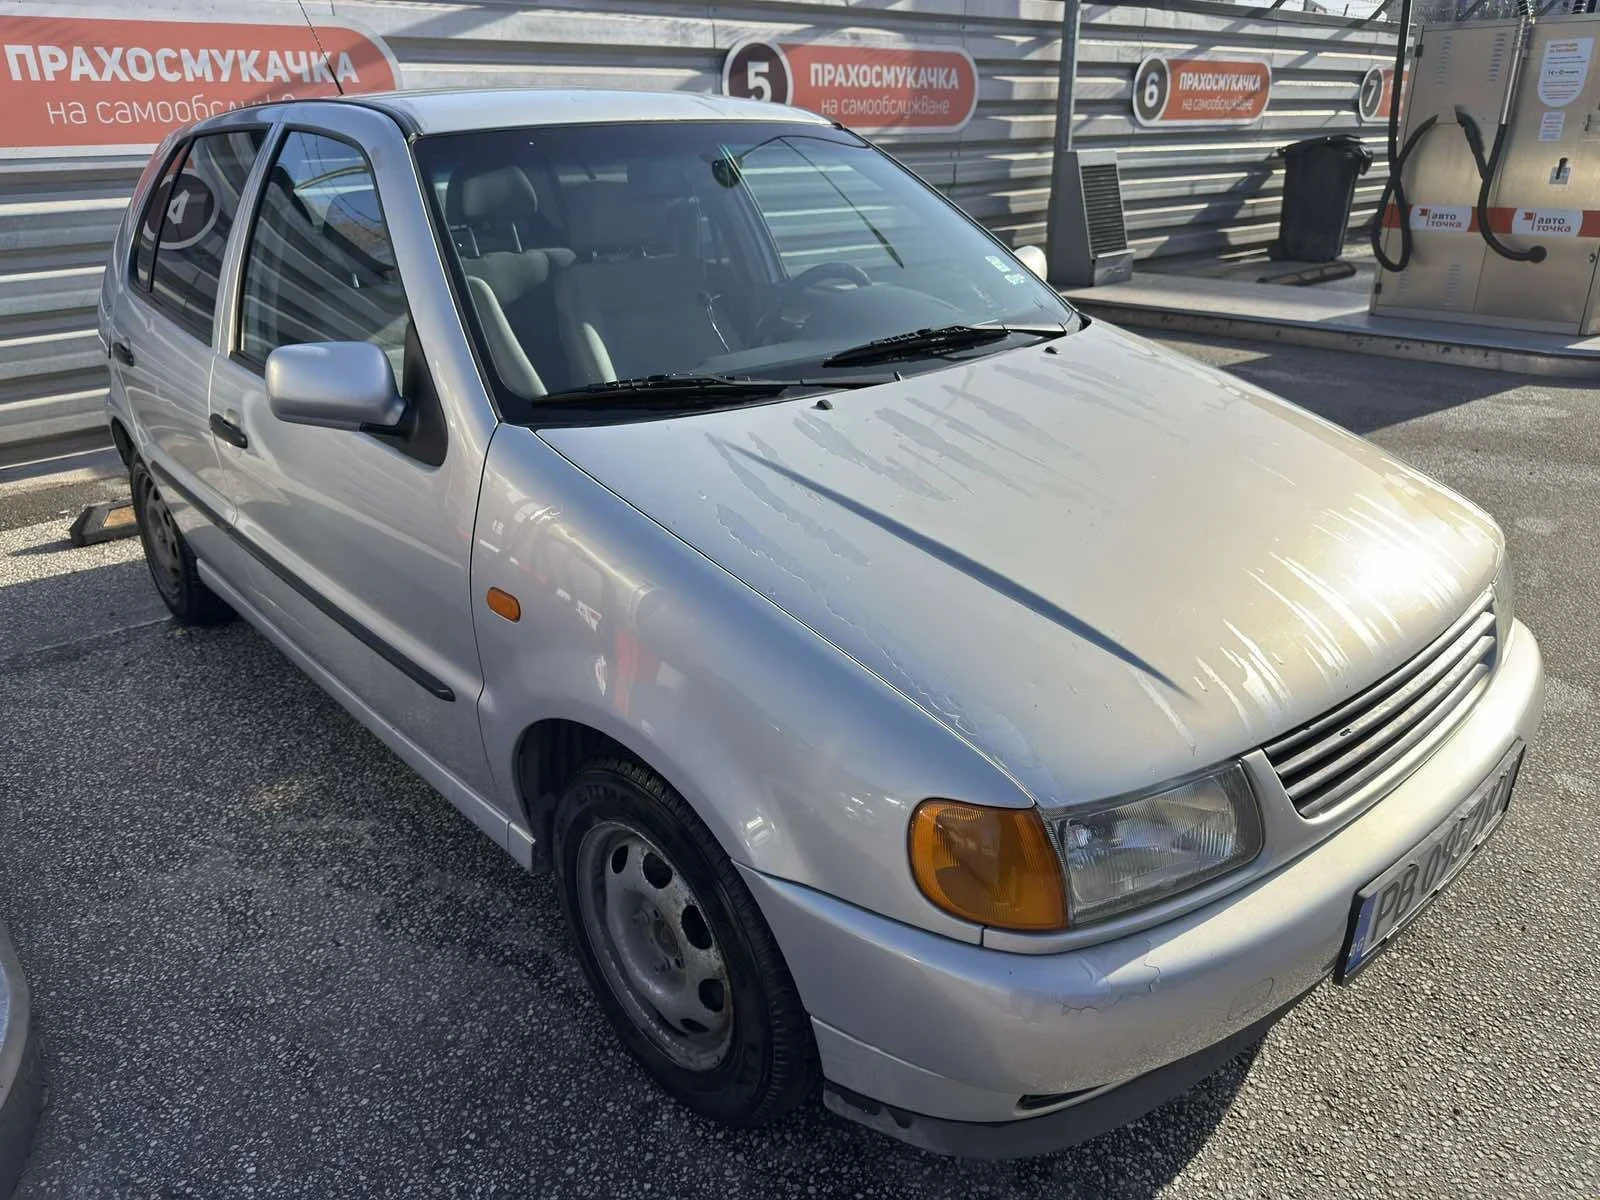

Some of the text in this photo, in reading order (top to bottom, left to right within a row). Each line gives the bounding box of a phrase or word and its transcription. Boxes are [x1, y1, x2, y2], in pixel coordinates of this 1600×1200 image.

[4, 44, 360, 84] ПРАХОСМУКАЧКА
[810, 62, 959, 90] ПРАХОСМУКАЧКА
[747, 62, 772, 103] 5
[1143, 72, 1160, 108] 6
[1179, 72, 1261, 92] ПРАХОСМУКАЧКА
[1366, 79, 1378, 107] 7
[47, 99, 87, 125] на
[821, 96, 950, 119] на самообслужване
[1430, 220, 1463, 229] точка
[1431, 212, 1457, 221] авто
[1536, 224, 1572, 233] точка
[1537, 216, 1566, 225] авто
